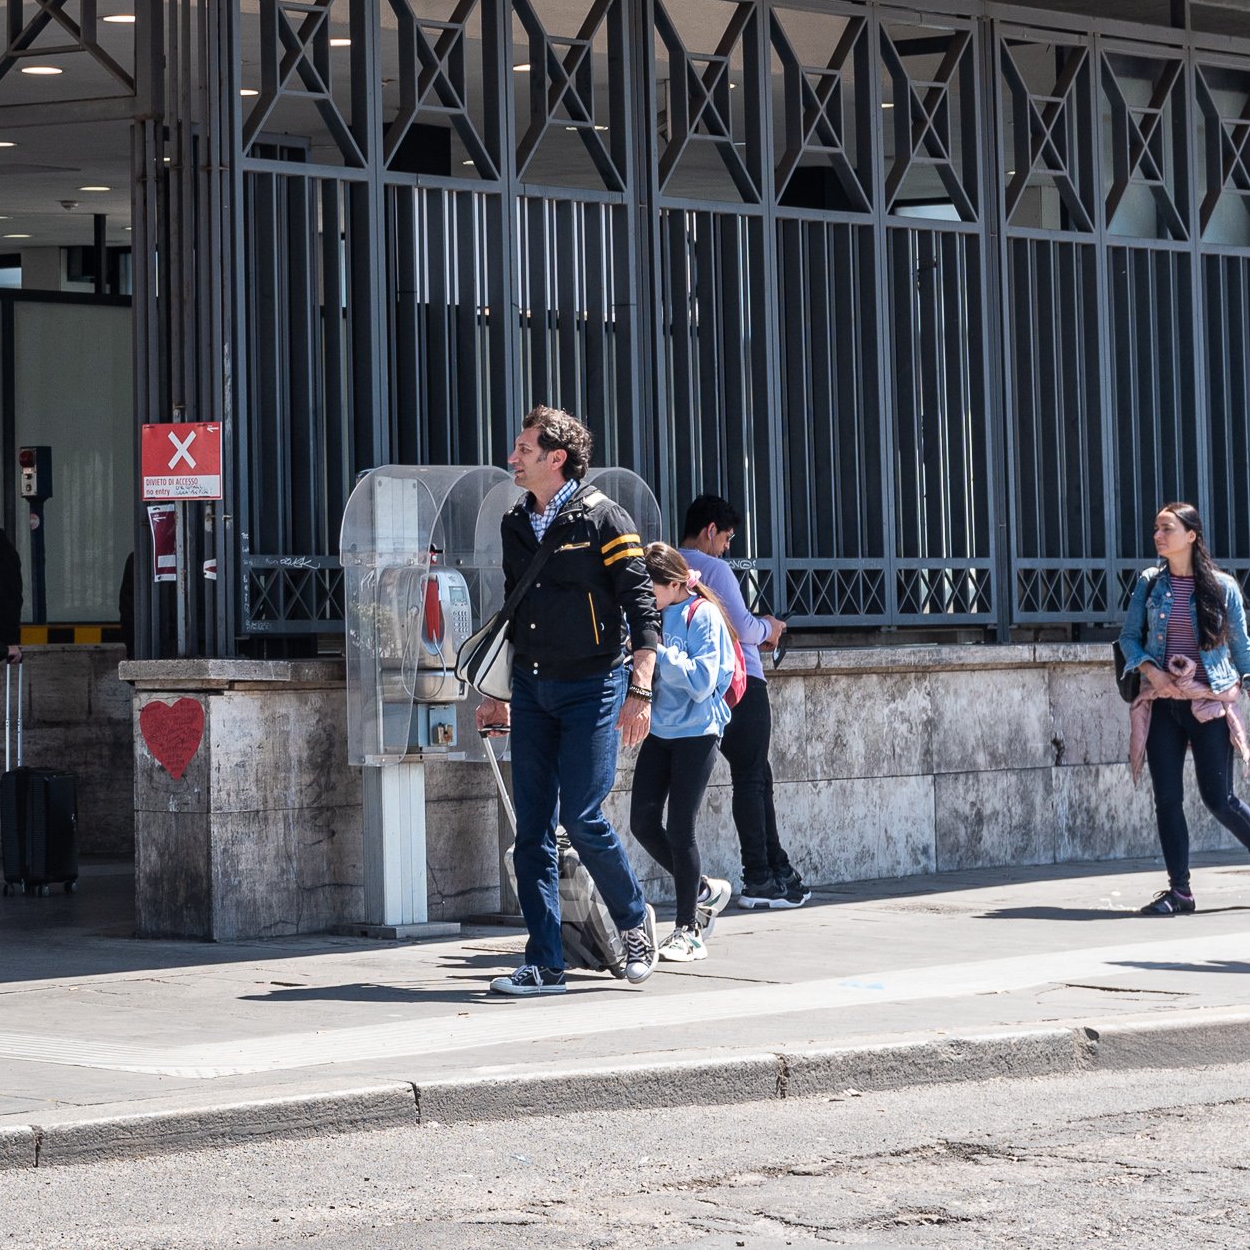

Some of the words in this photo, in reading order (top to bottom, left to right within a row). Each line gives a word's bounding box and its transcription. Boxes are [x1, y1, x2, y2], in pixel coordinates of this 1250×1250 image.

[146, 478, 167, 486] DIVIETO
[168, 478, 175, 486] DI
[175, 477, 198, 485] ACCESSO
[155, 487, 170, 496] entry
